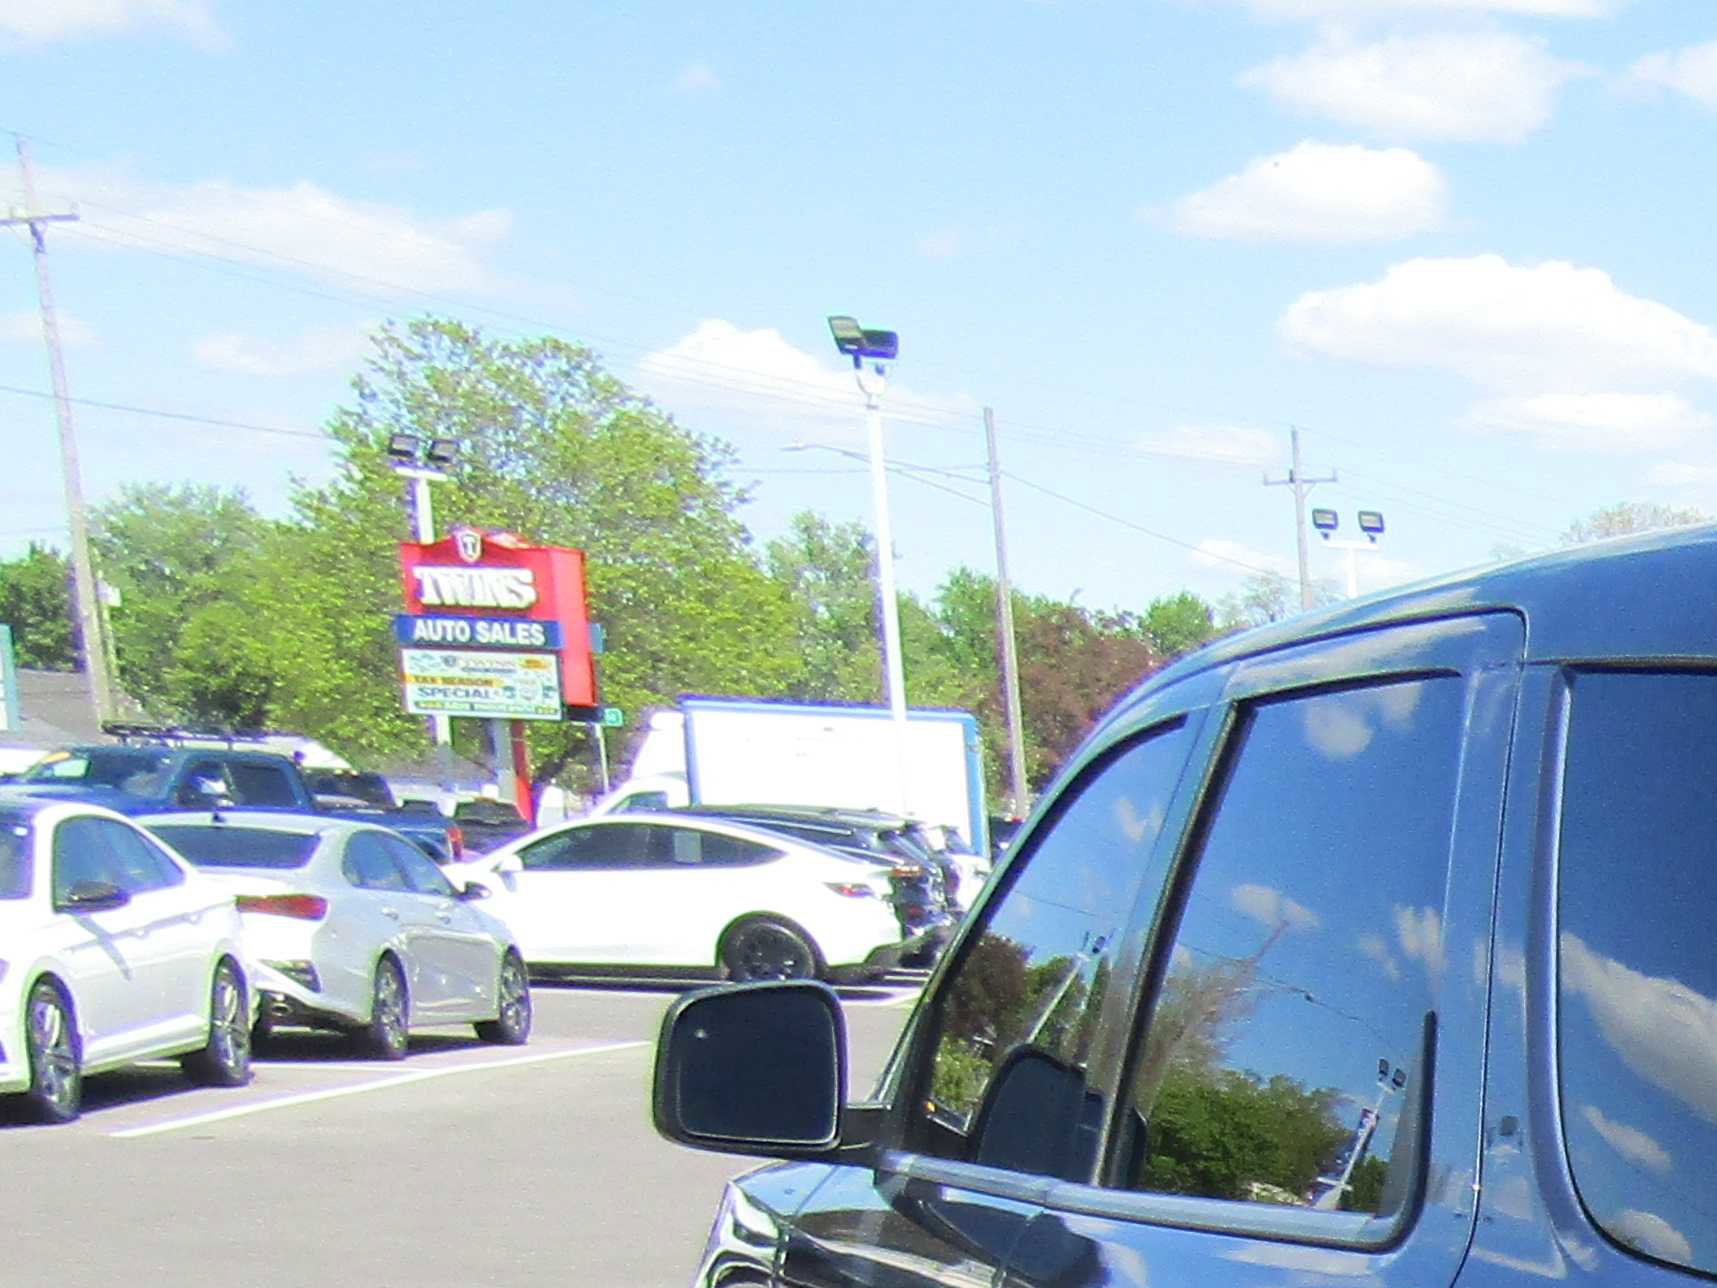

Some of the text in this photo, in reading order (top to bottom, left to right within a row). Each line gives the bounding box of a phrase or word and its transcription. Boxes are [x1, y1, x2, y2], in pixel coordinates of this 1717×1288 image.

[413, 565, 538, 609] TWINS
[413, 620, 545, 645] AUTO SALES
[417, 687, 492, 699] SPECIAL
